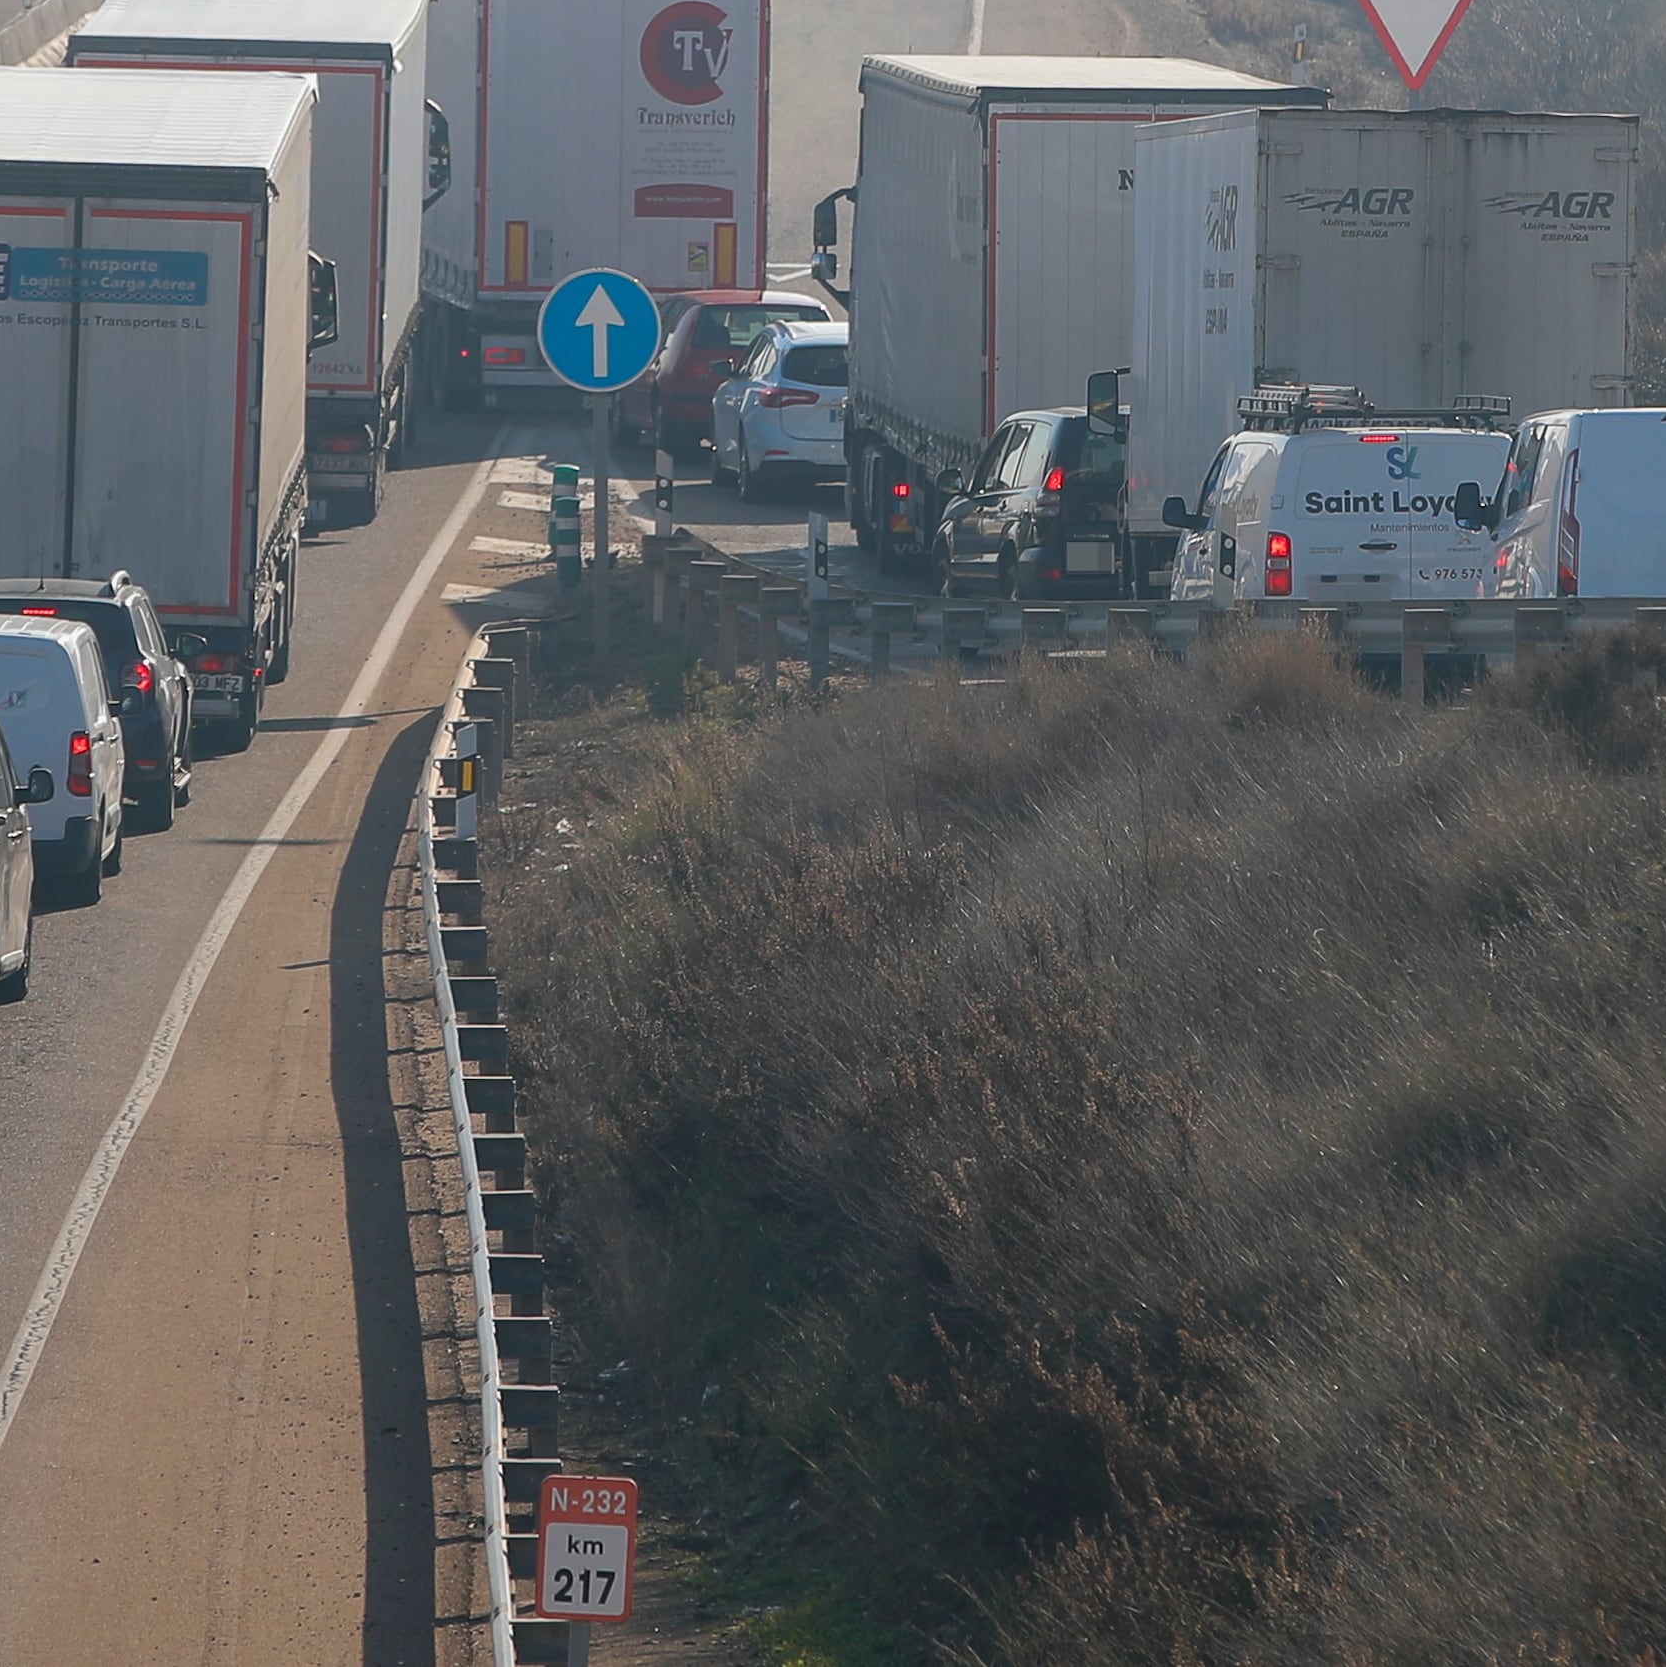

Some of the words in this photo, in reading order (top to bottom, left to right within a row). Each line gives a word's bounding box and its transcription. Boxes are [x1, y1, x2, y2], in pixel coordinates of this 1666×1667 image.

[636, 106, 737, 128] Transverich
[1332, 187, 1414, 215] AGR
[1533, 190, 1615, 219] AGR
[1368, 219, 1412, 228] Navarra
[1569, 222, 1612, 232] Navarra
[100, 277, 146, 292] Carga
[94, 315, 178, 331] Transportes
[1305, 489, 1384, 514] Saint
[1369, 522, 1450, 534] Mantenimientos
[1434, 568, 1457, 581] 976
[551, 1487, 627, 1515] N-232
[567, 1534, 604, 1556] km
[552, 1567, 617, 1606] 217
